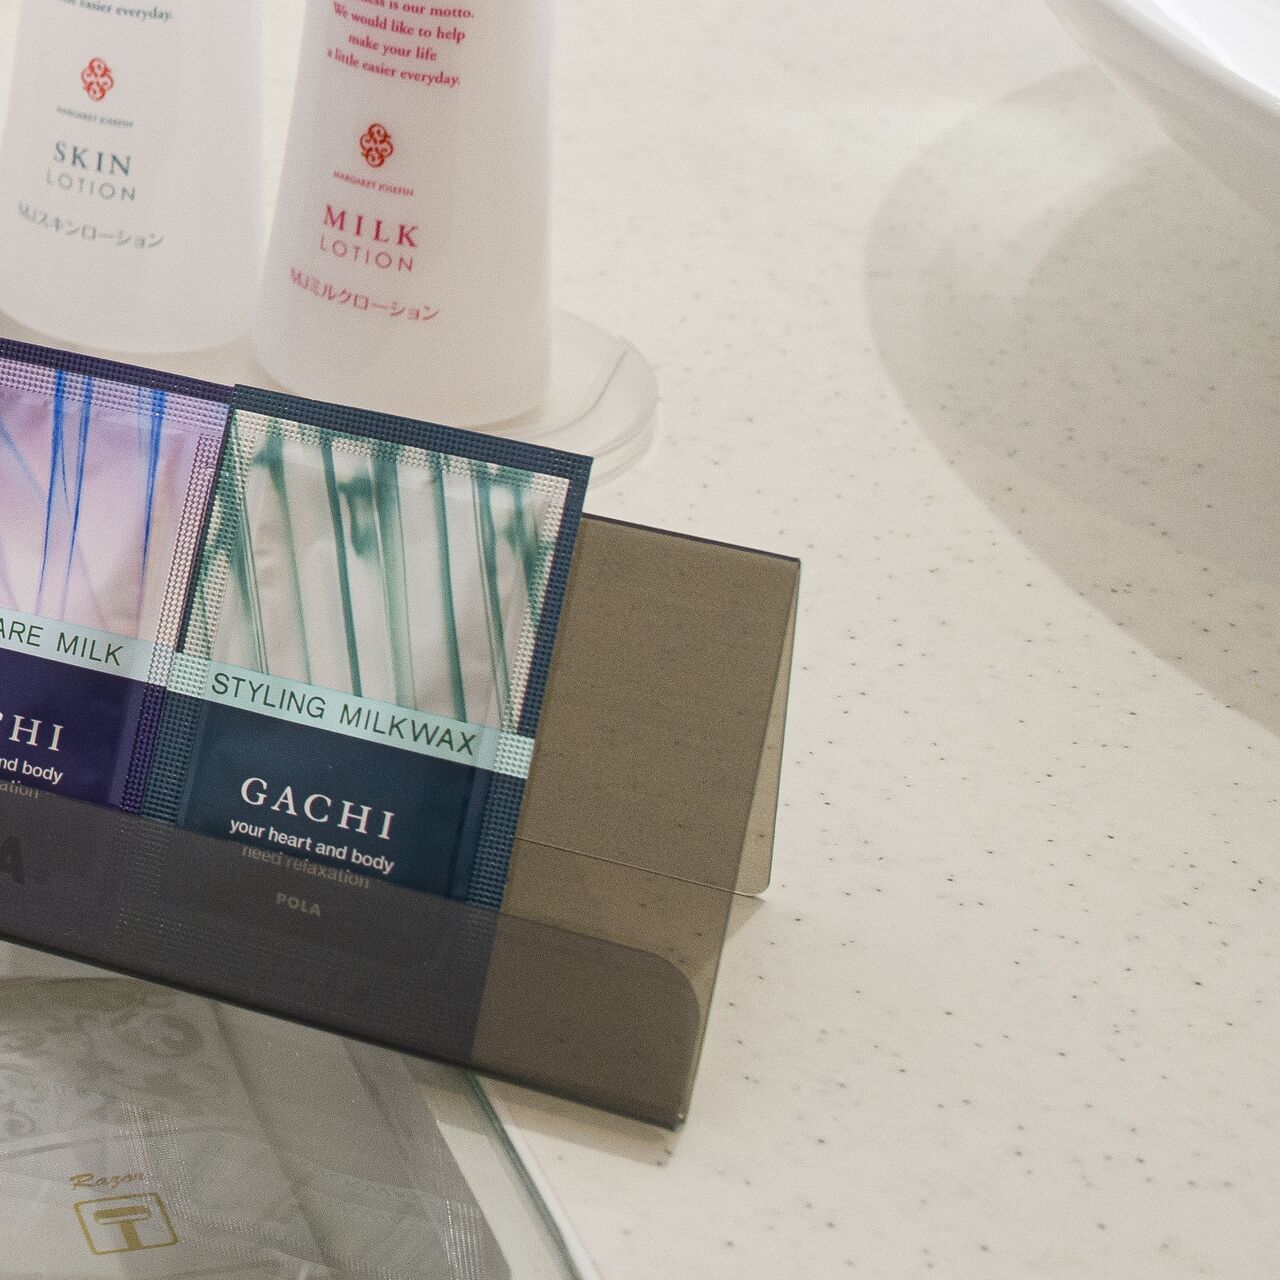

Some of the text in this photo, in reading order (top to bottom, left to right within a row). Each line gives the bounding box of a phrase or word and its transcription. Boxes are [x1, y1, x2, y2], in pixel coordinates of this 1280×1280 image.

[116, 4, 173, 22] everyday.
[333, 2, 465, 45] We would like to help
[403, 2, 426, 15] our
[430, 6, 474, 19] motto.
[349, 33, 437, 62] make your life
[334, 48, 359, 69] little
[363, 60, 396, 78] easier
[400, 67, 461, 88] everyday.
[53, 140, 131, 177] SKIN
[46, 170, 136, 201] LOTION
[323, 203, 419, 248] MILK
[320, 233, 414, 272] LOTION
[56, 632, 125, 667] MILK
[211, 672, 476, 757] STYLING MILKWAX
[22, 761, 63, 785] body
[240, 777, 395, 840] GACHI
[229, 819, 395, 874] your heart and body
[275, 892, 321, 917] POLA
